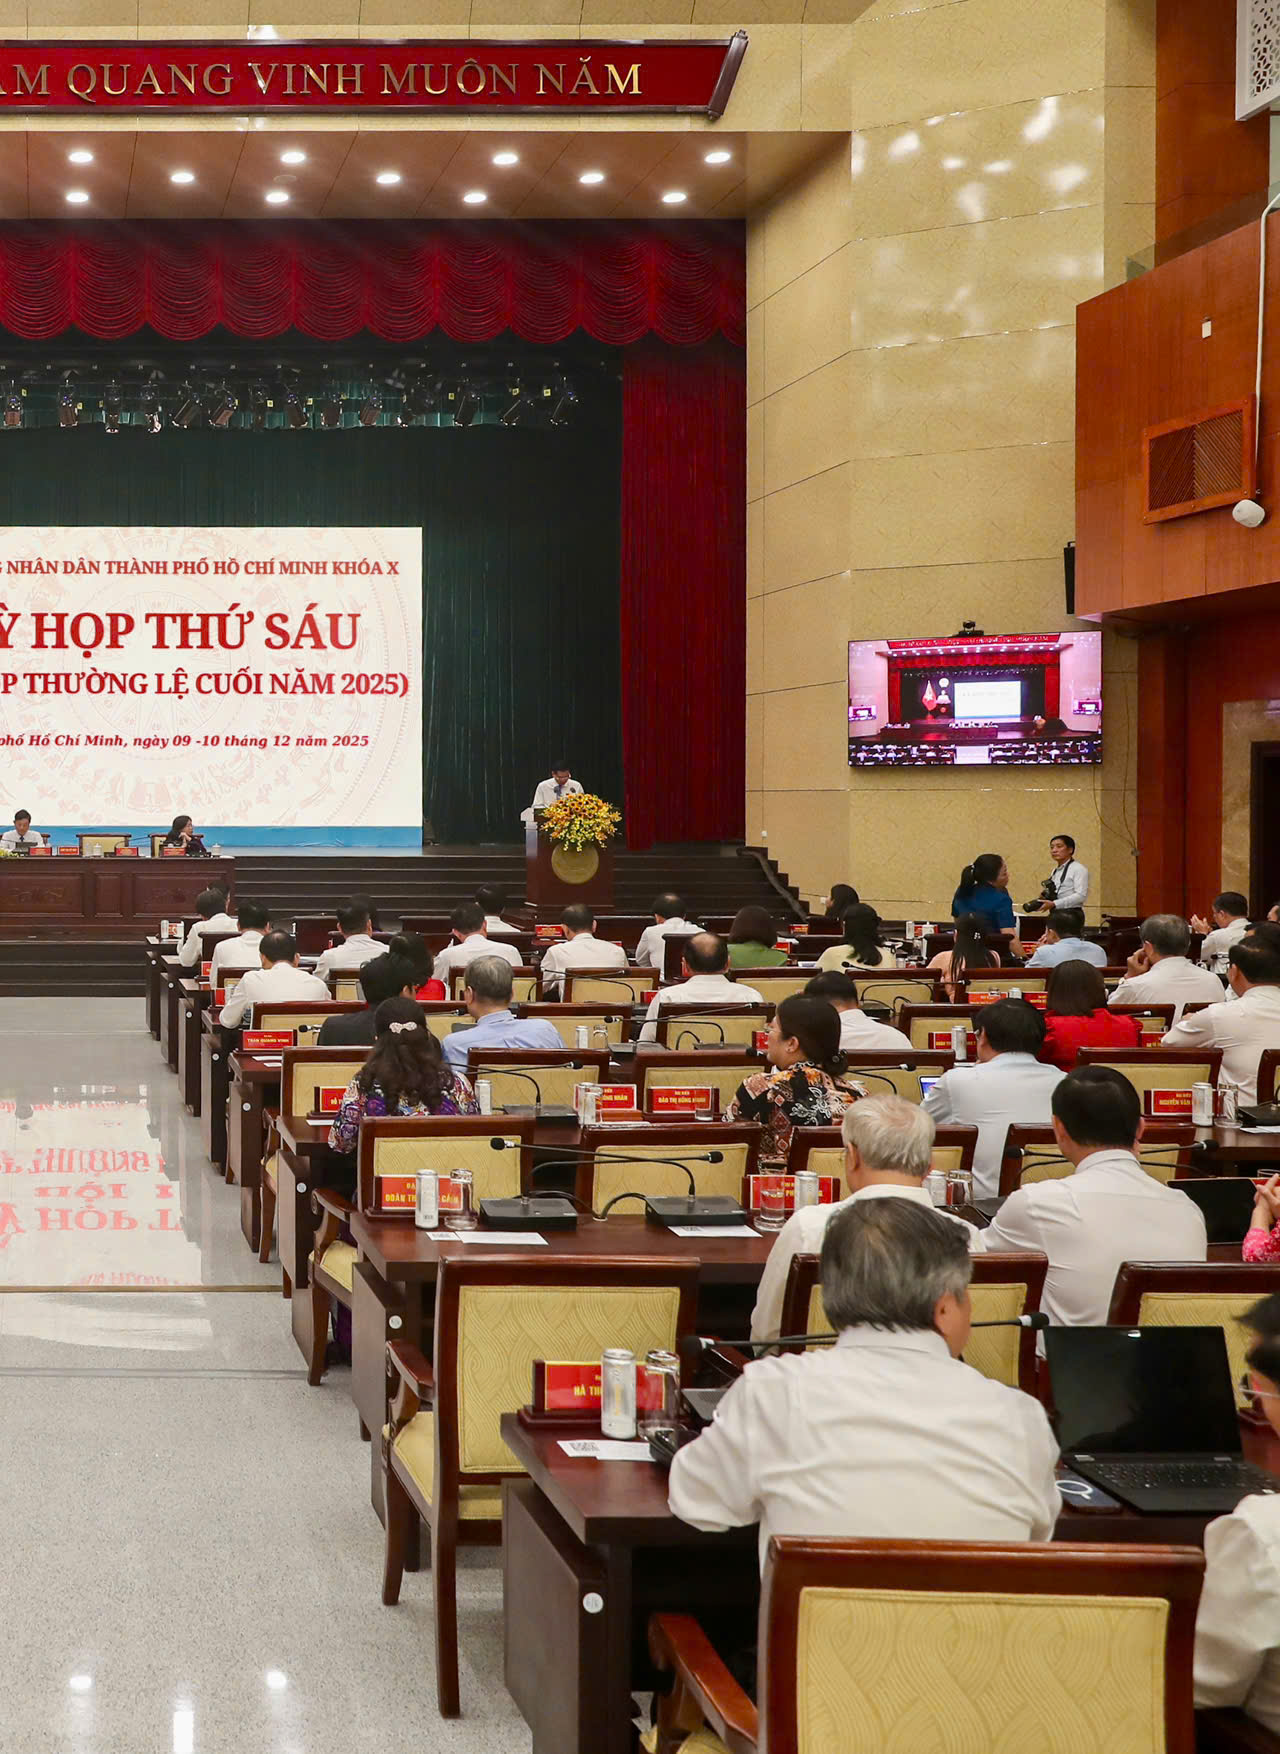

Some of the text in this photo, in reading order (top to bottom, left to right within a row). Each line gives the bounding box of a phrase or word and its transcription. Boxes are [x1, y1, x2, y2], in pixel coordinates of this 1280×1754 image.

[67, 64, 234, 103] QUANG
[248, 63, 365, 96] VINH
[381, 59, 519, 96] MUÔN
[535, 57, 643, 96] NĂM
[7, 557, 59, 575] NHÂN
[63, 557, 101, 575] DÂN
[104, 557, 169, 575] THÀNH
[173, 557, 210, 575] PHỐ
[213, 557, 241, 575] HỒ
[244, 557, 275, 575] CHÍ
[279, 560, 329, 575] MINH
[332, 558, 384, 575] KHÓA
[387, 560, 400, 575] X
[31, 611, 136, 660] HỌP
[145, 602, 255, 651] THỨ
[264, 602, 361, 651] SÁU
[23, 667, 149, 695] THƯỜNG
[154, 667, 190, 700] LỆ
[195, 666, 264, 695] CUỐI
[269, 667, 336, 695] NĂM
[340, 672, 410, 698] 2025)
[54, 735, 80, 747] Chí
[84, 735, 128, 748] Minh,
[133, 735, 169, 750] ngày
[172, 735, 192, 747] 09
[195, 735, 221, 747] -10
[224, 735, 268, 750] tháng
[273, 735, 291, 747] 12
[295, 735, 328, 747] năm
[332, 735, 370, 747] 2025
